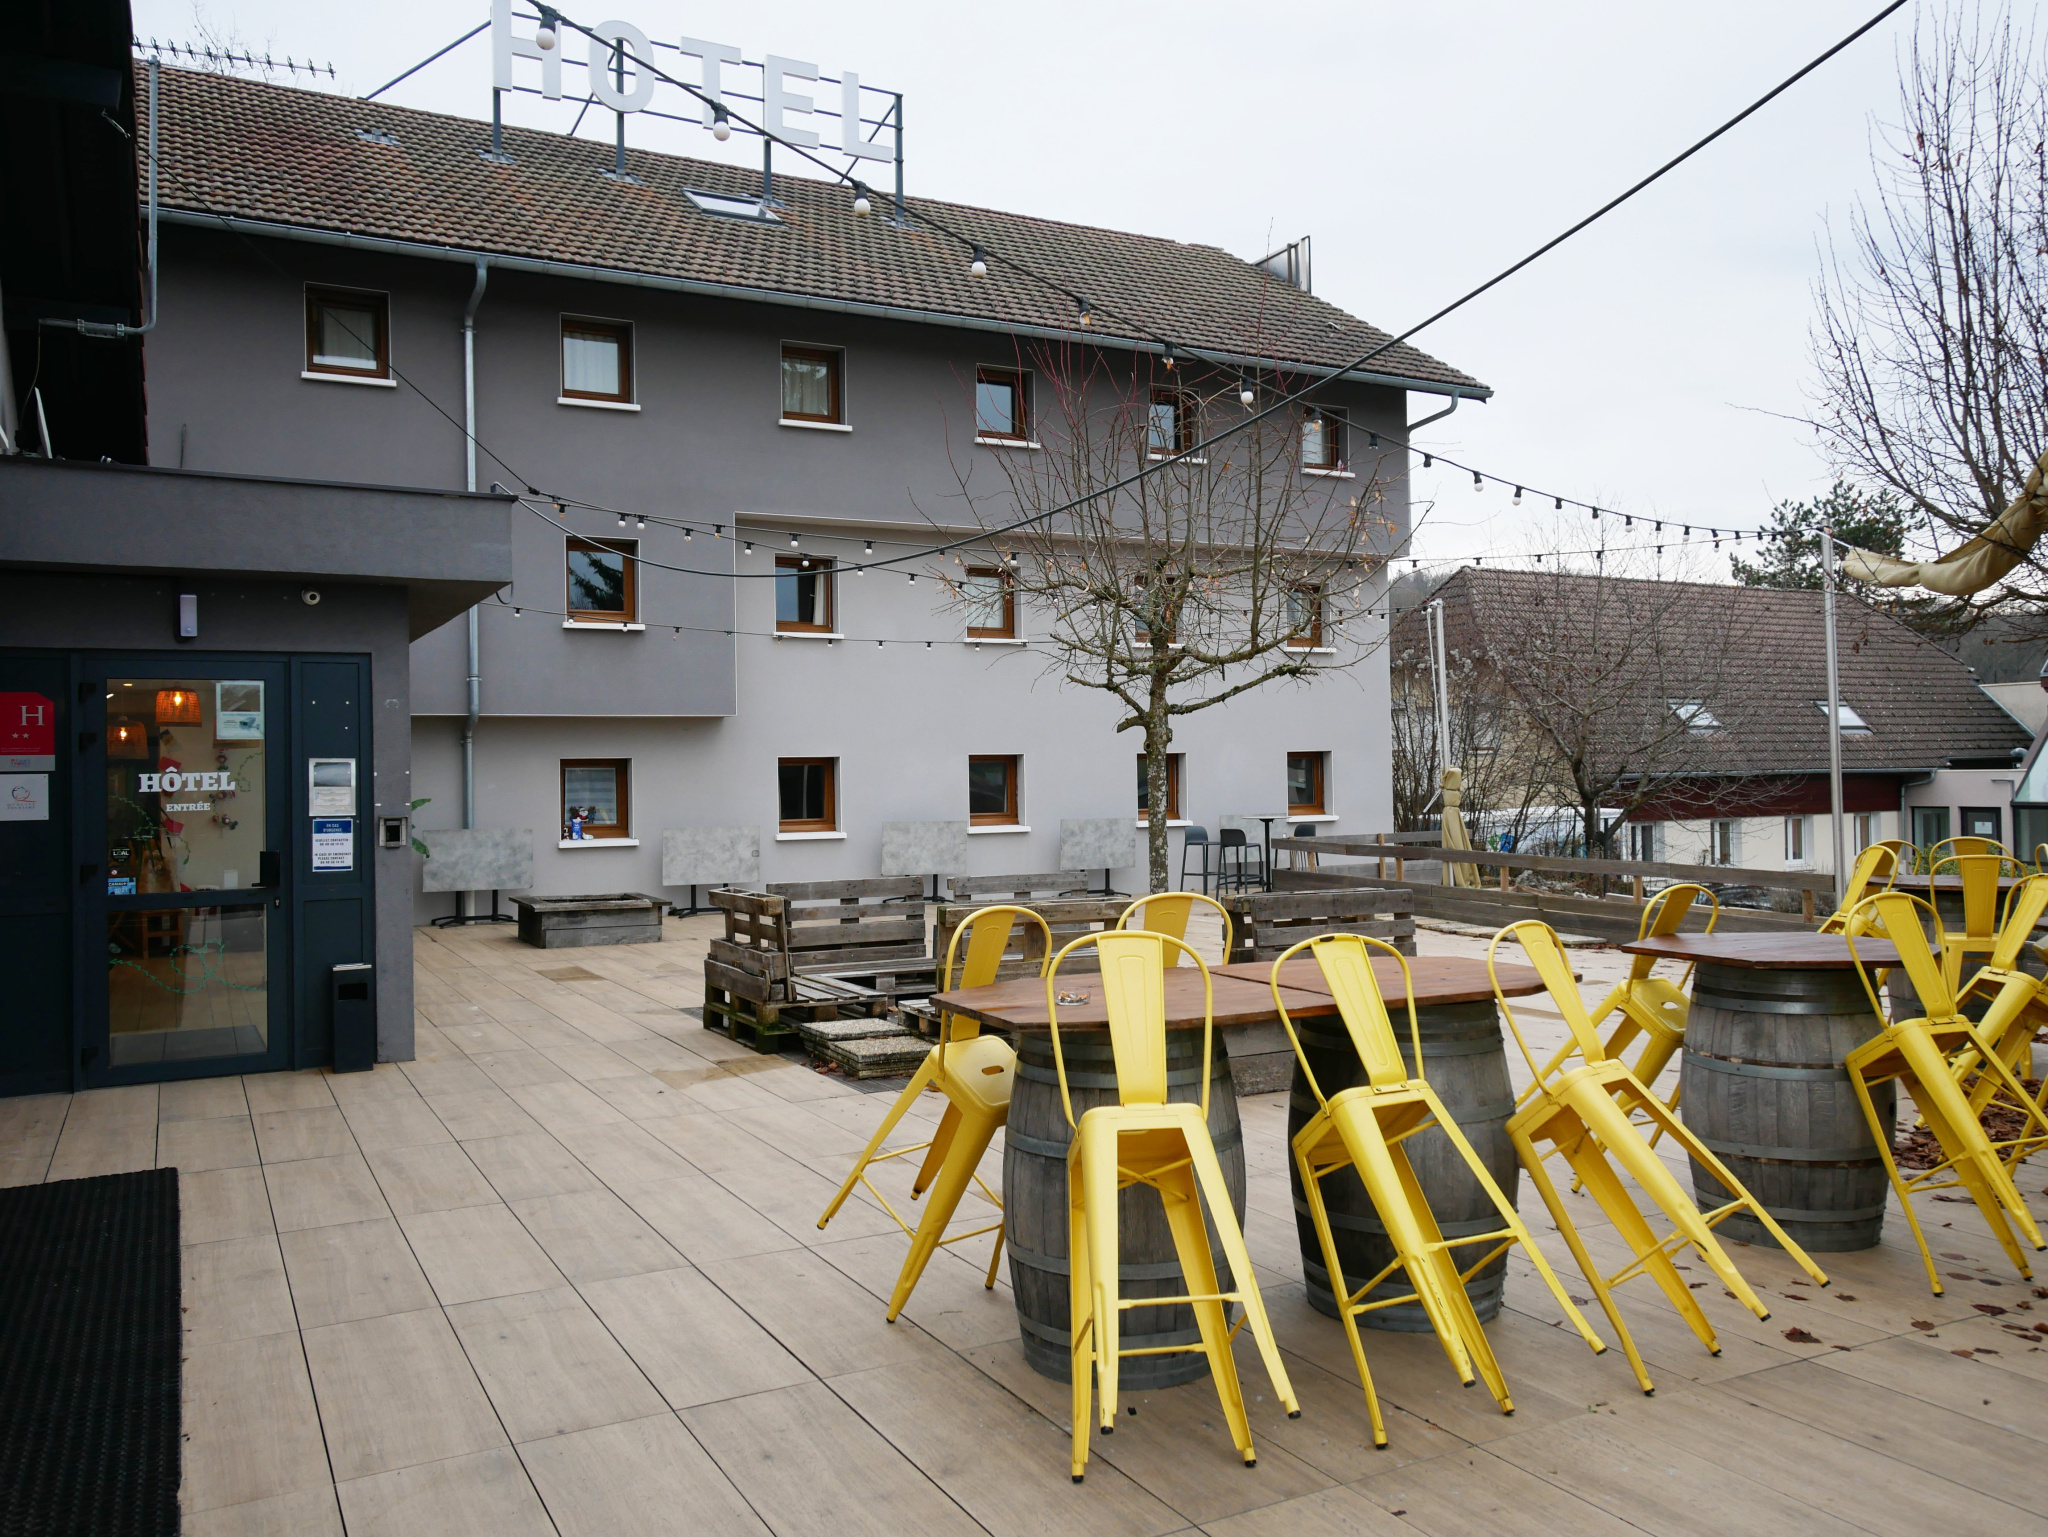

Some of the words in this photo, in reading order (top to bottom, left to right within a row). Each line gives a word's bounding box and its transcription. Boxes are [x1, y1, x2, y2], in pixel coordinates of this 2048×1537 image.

[491, 0, 894, 163] HOTEL
[20, 705, 45, 726] H
[138, 766, 236, 793] HÔTEL
[165, 801, 211, 812] ENTRÉE
